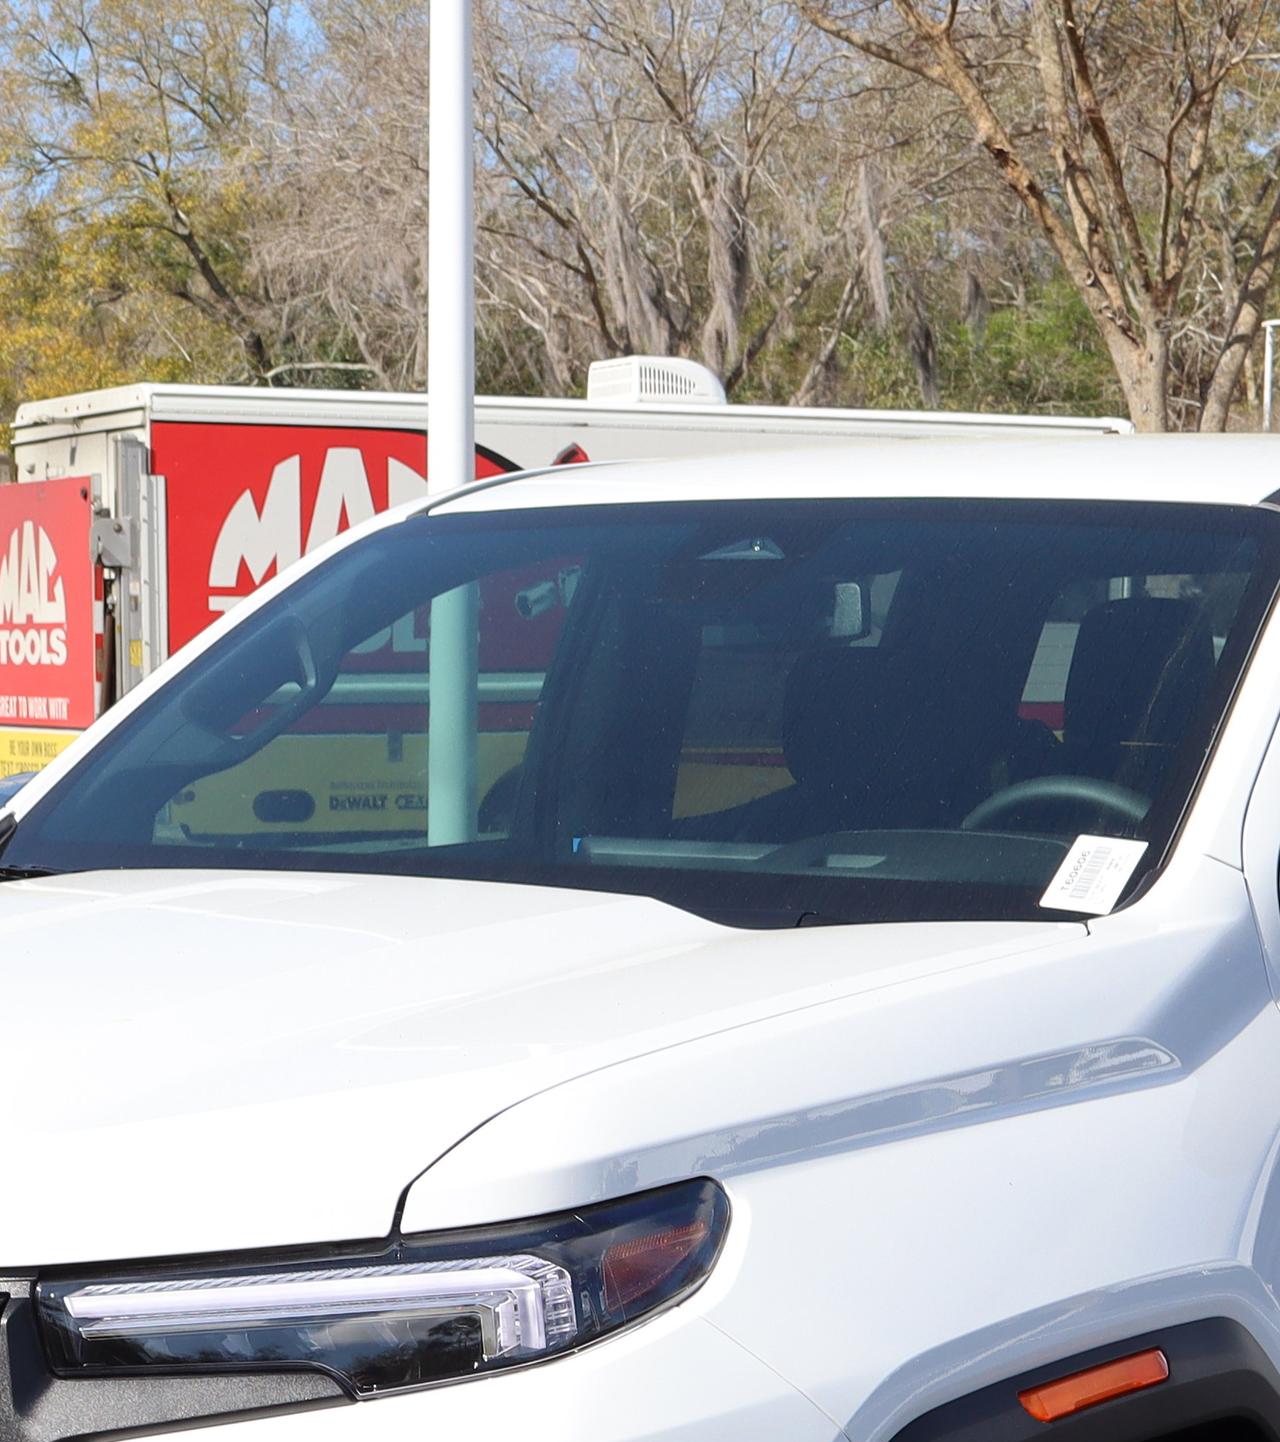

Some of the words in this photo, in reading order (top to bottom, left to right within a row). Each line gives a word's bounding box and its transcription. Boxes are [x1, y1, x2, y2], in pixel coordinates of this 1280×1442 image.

[18, 695, 28, 719] TO
[28, 696, 48, 719] WORK
[48, 697, 68, 720] WITH
